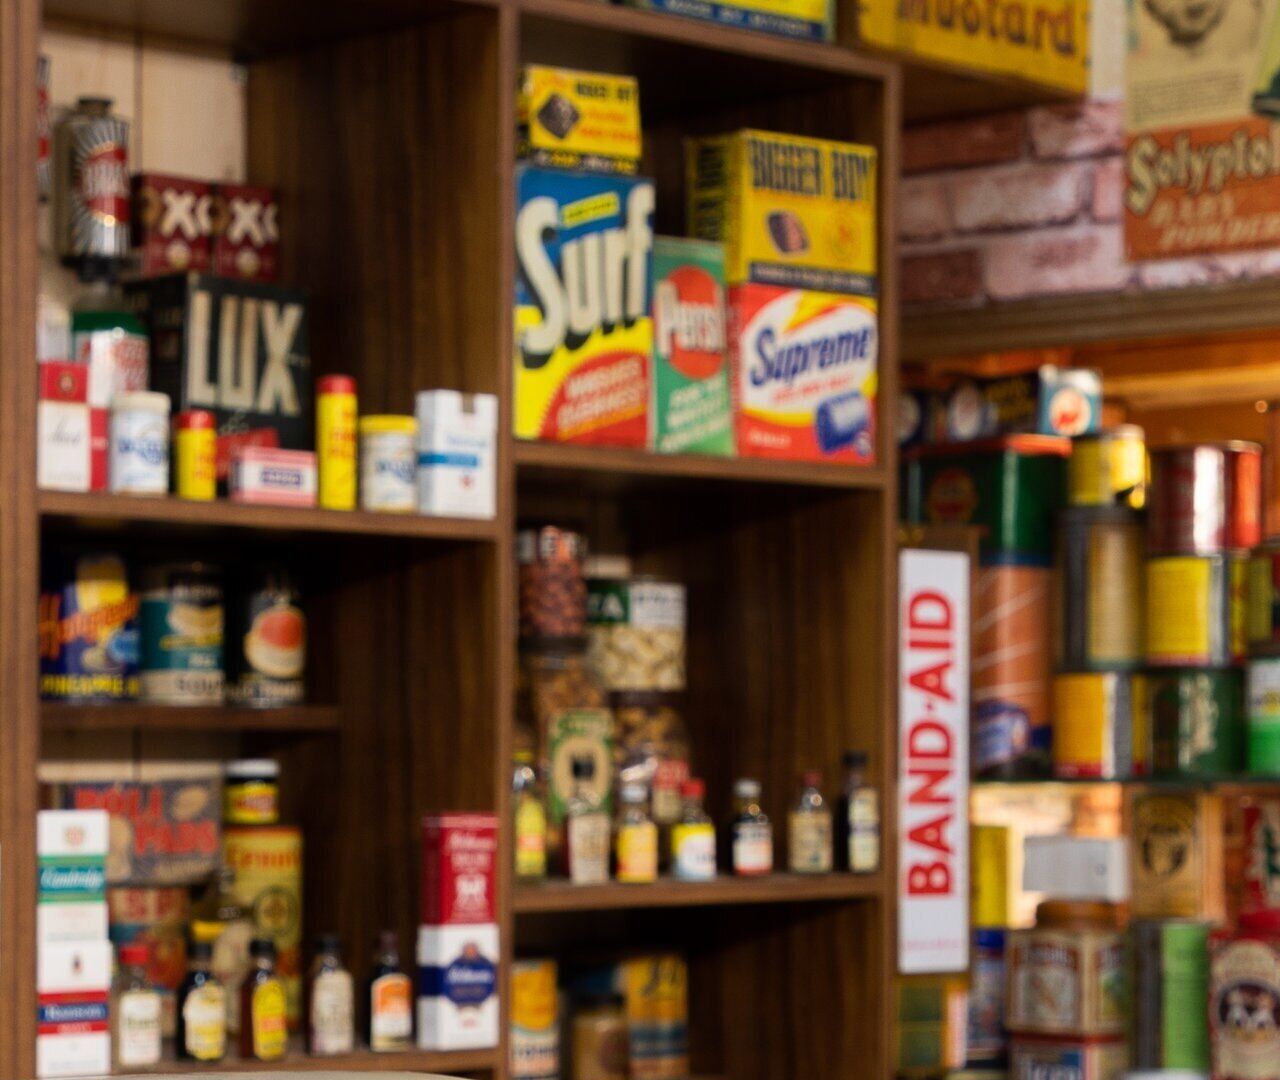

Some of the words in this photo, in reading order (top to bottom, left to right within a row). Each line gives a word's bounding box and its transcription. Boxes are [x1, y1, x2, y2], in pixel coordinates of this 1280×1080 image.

[516, 182, 657, 356] Surf
[184, 288, 306, 417] LUX
[750, 325, 872, 388] Supreme
